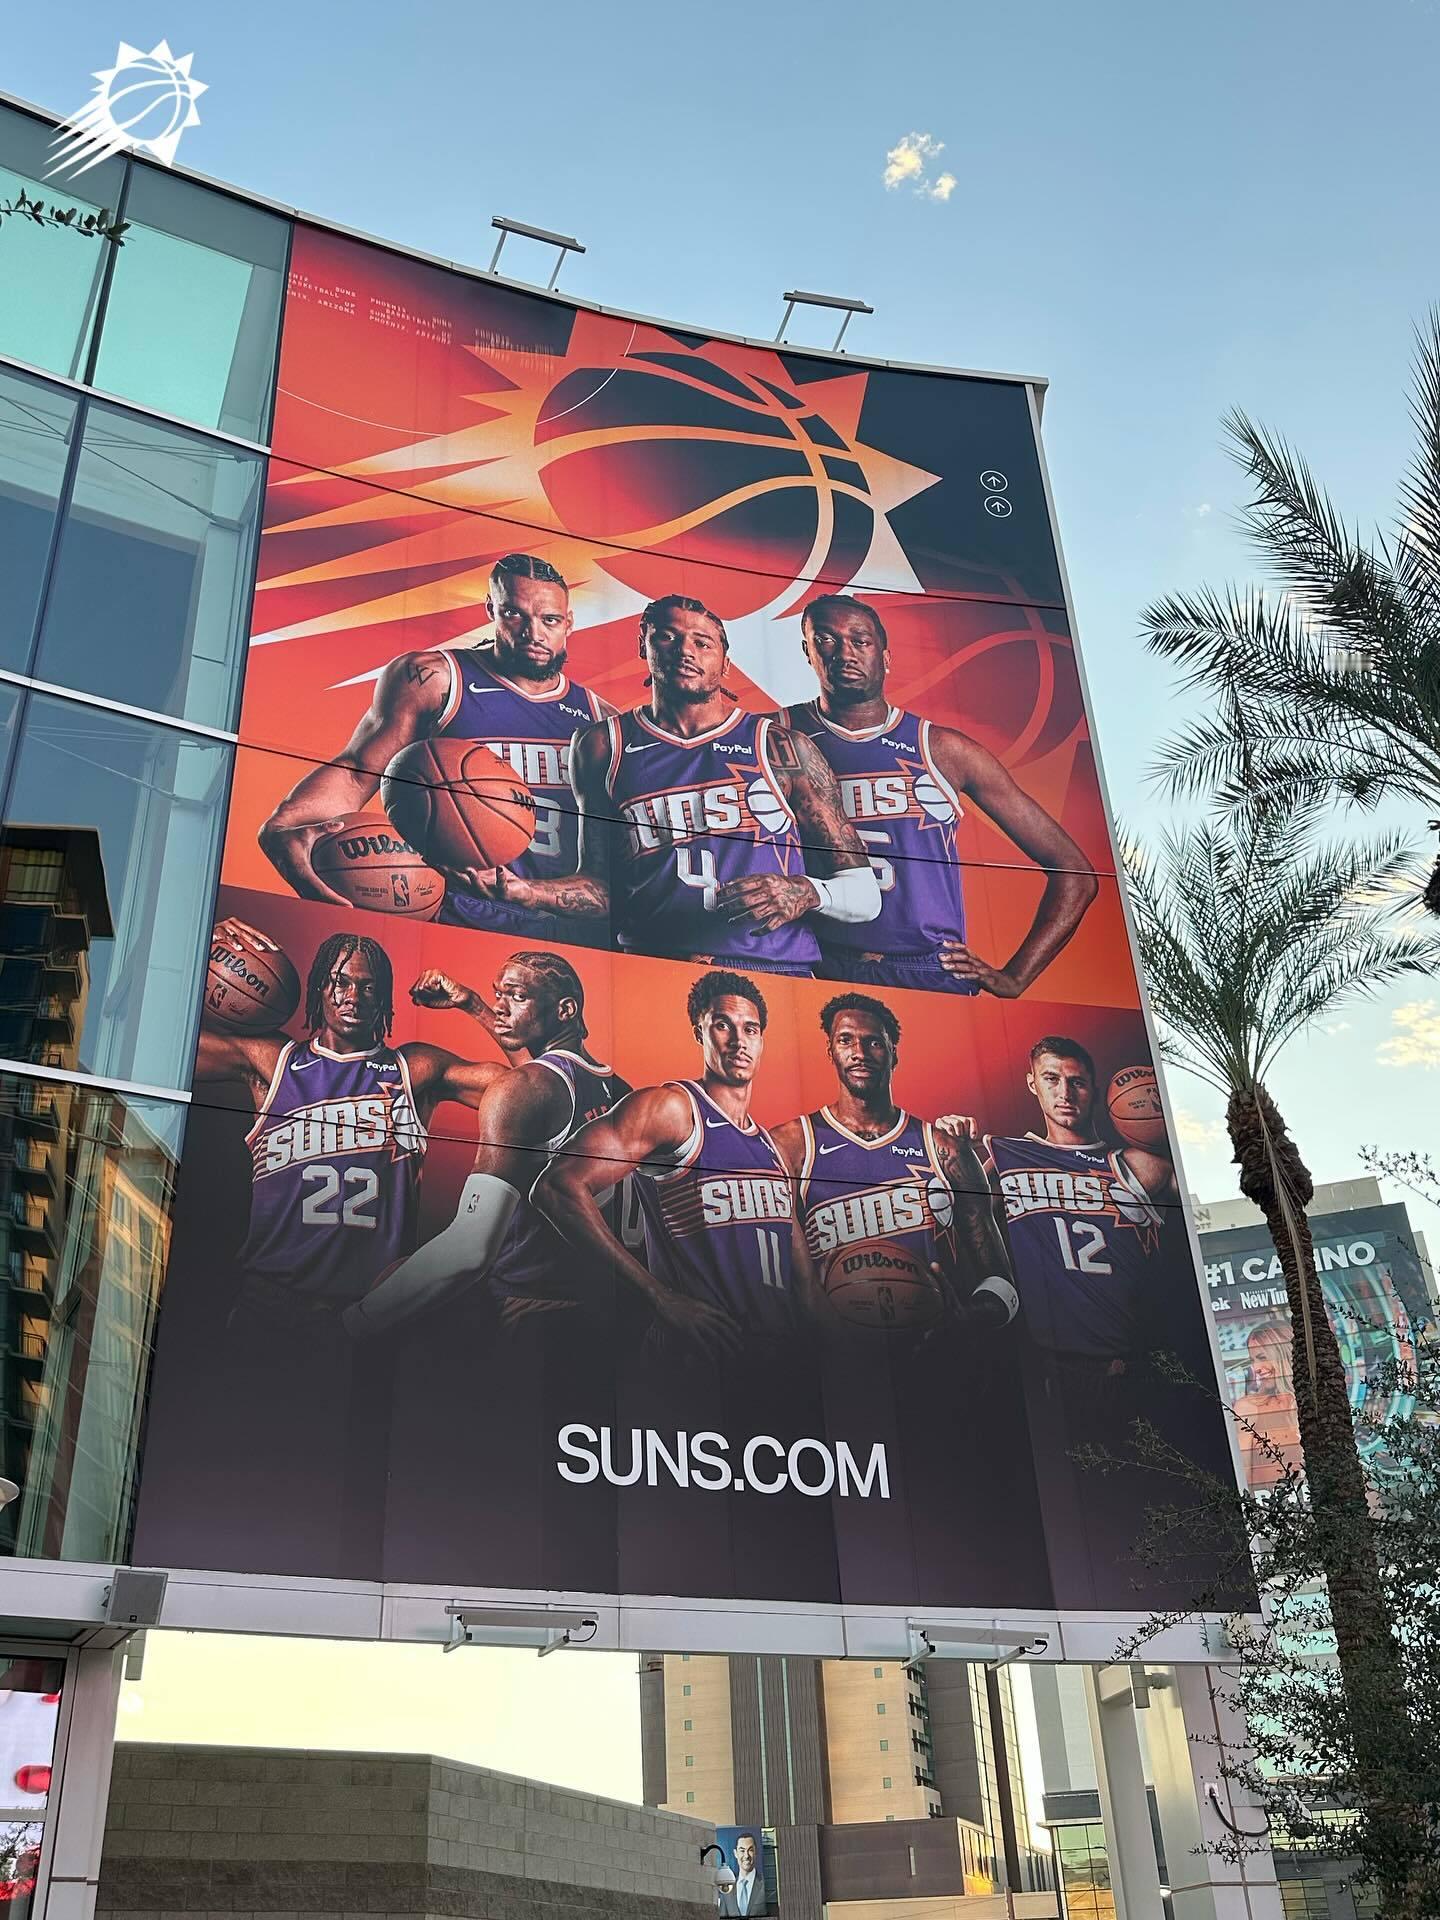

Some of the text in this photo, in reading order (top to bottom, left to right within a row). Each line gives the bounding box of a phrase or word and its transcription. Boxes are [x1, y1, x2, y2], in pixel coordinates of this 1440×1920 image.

[558, 702, 591, 721] PayPal
[712, 742, 753, 755] PayPal
[881, 737, 916, 754] PayPal
[674, 847, 721, 912] 4
[209, 945, 271, 999] Wilson
[366, 1061, 398, 1073] PayPal
[265, 1099, 388, 1172] SUNS
[891, 1145, 924, 1158] PayPal
[1075, 1150, 1105, 1164] PayPal
[302, 1164, 379, 1229] 22
[1000, 1172, 1106, 1216] SUNS
[814, 1187, 925, 1252] SUNS
[755, 1227, 785, 1290] 11
[841, 1251, 920, 1275] Wilson
[1052, 1216, 1114, 1276] 12
[1204, 1241, 1376, 1288] #1 CAINO
[1240, 1291, 1269, 1310] New
[556, 1422, 891, 1499] SUNS.COM
